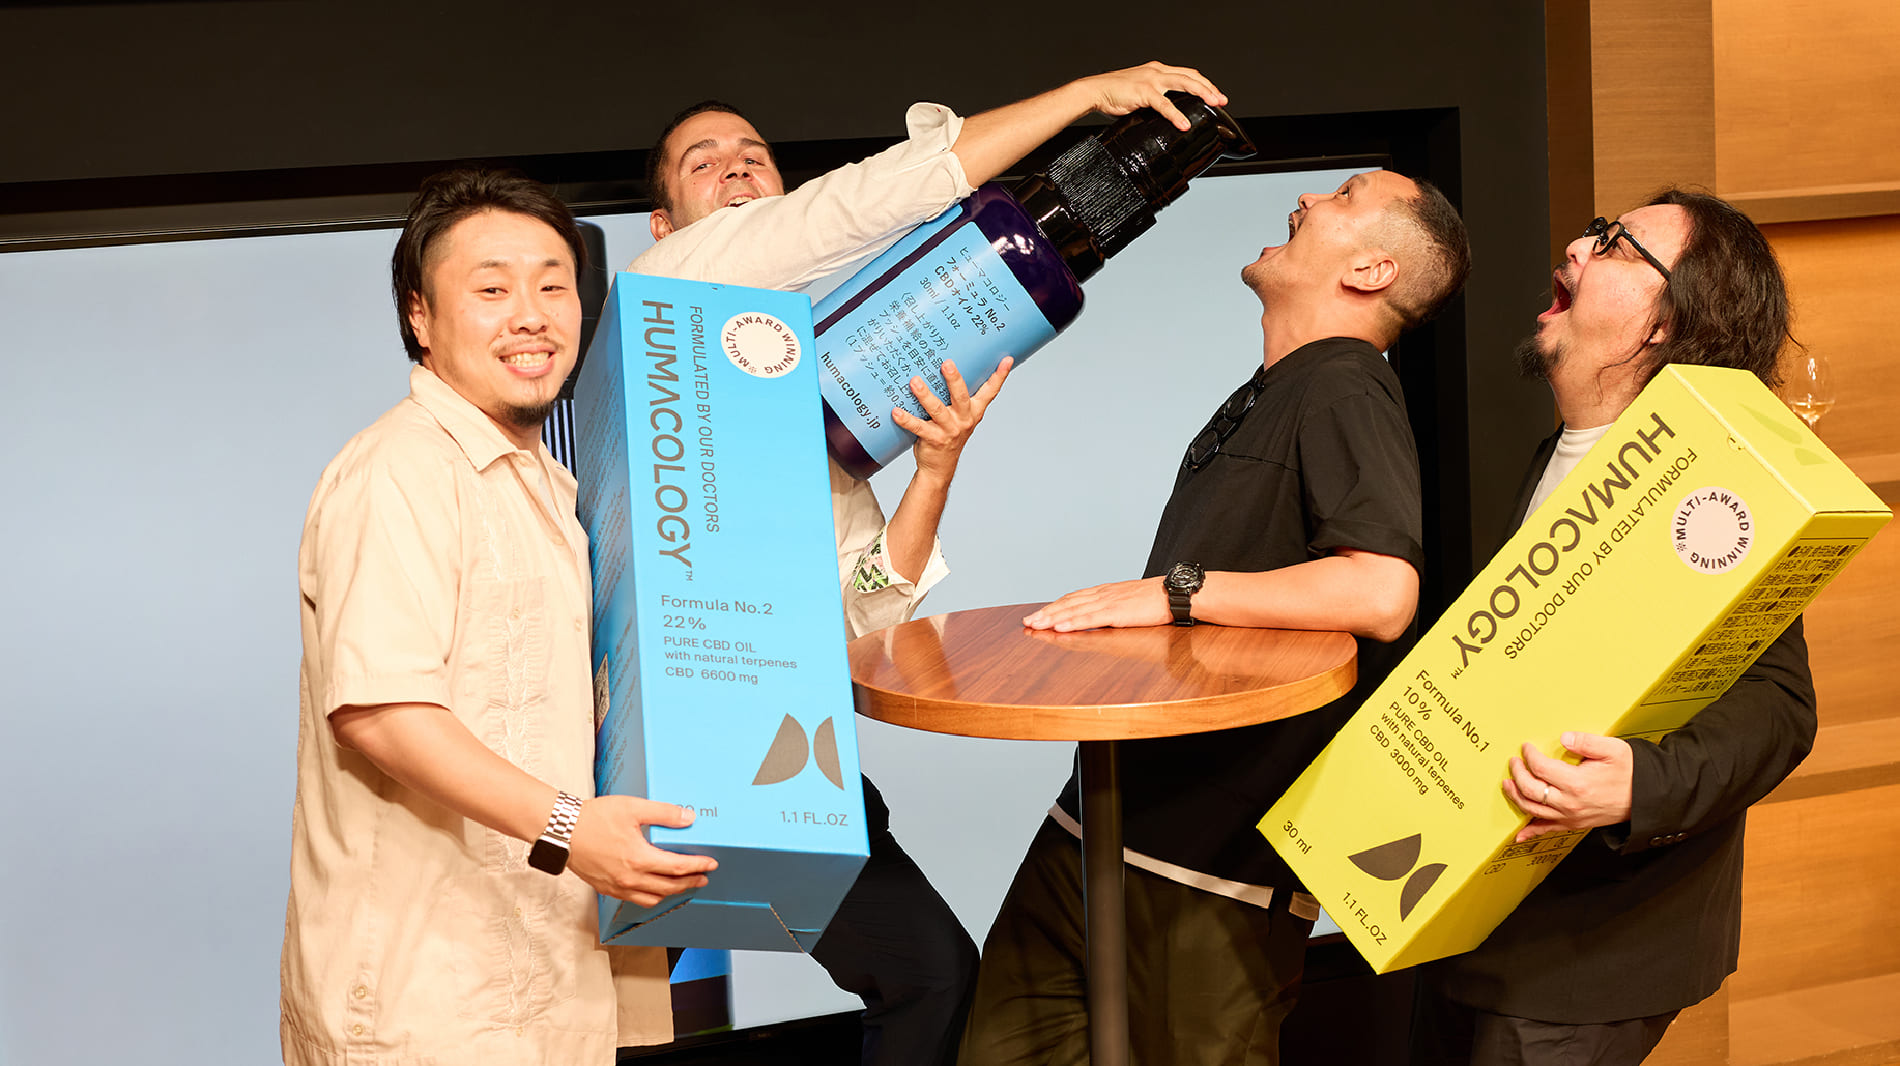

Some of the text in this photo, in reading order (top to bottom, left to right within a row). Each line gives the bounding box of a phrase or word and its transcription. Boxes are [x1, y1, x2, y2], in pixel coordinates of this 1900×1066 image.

[935, 266, 988, 335] CBDオイル 22%
[947, 256, 1005, 332] フォーミュラ No.2
[960, 247, 1010, 311] ヒューマコロジー
[942, 306, 961, 330] 1.1oz
[726, 316, 796, 374] MULTI-AWARD WINNING
[821, 352, 881, 429] humacology.jp
[690, 306, 719, 532] FORMULATED BY OUR DOCTORS
[1676, 492, 1750, 540] MULTI-AWARD
[1504, 448, 1697, 659] FORMULATED BY OUR DOCTORS
[1690, 537, 1750, 570] WINNING
[661, 595, 772, 615] Formula No.2
[664, 615, 706, 630] 22%
[664, 636, 757, 653] PURE CBD OIL
[665, 651, 797, 668] with natural terpenes
[666, 667, 694, 678] CBD
[701, 669, 736, 681] 6600
[1403, 686, 1432, 720] 10%
[1416, 669, 1490, 752] Formula No.1
[1370, 725, 1390, 748] CBD
[1390, 749, 1415, 777] 3000
[1381, 713, 1464, 809] with natural terpenes
[1389, 701, 1448, 773] PURE CBD OIL
[699, 806, 718, 817] ml
[780, 811, 848, 827] 1.1 FL.OZ
[1283, 821, 1312, 854] 30 ml
[1343, 892, 1387, 946] 1.1 FL.OZ
